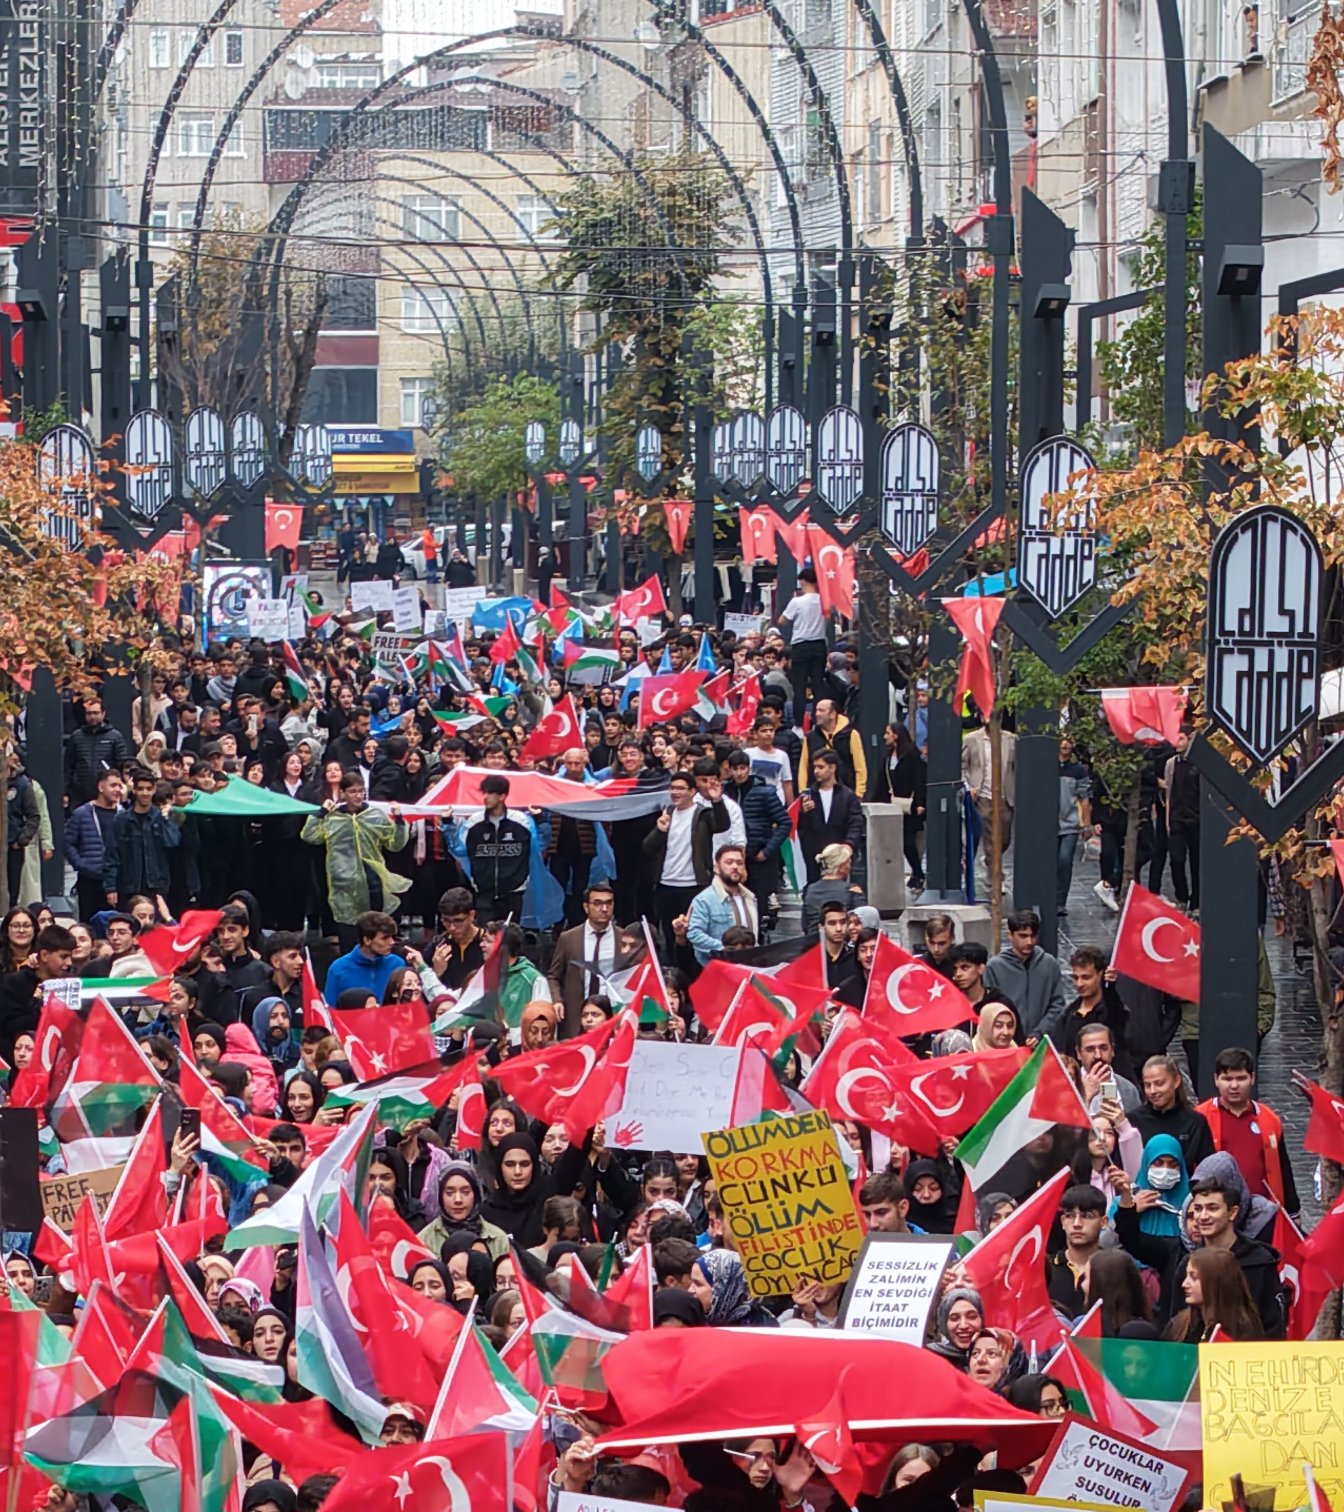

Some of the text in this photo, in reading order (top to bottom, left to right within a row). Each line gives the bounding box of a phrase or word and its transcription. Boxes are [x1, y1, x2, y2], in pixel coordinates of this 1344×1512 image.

[349, 434, 384, 443] TEKEL
[716, 1141, 840, 1182] KORKMA
[729, 1198, 834, 1239] ÖLÜM
[867, 1259, 939, 1271] SESSİZLİK
[868, 1273, 927, 1284] ZALİMİN
[854, 1287, 933, 1298] EN SEVDİĞİ
[869, 1301, 909, 1312] İTAAT
[851, 1316, 919, 1330] BİÇİMİDİR
[1206, 1386, 1333, 1414] DENİZE
[1088, 1434, 1165, 1475] ÇOCUKLAR
[1261, 1440, 1338, 1478] DAN
[1083, 1455, 1152, 1493] UYURKEN
